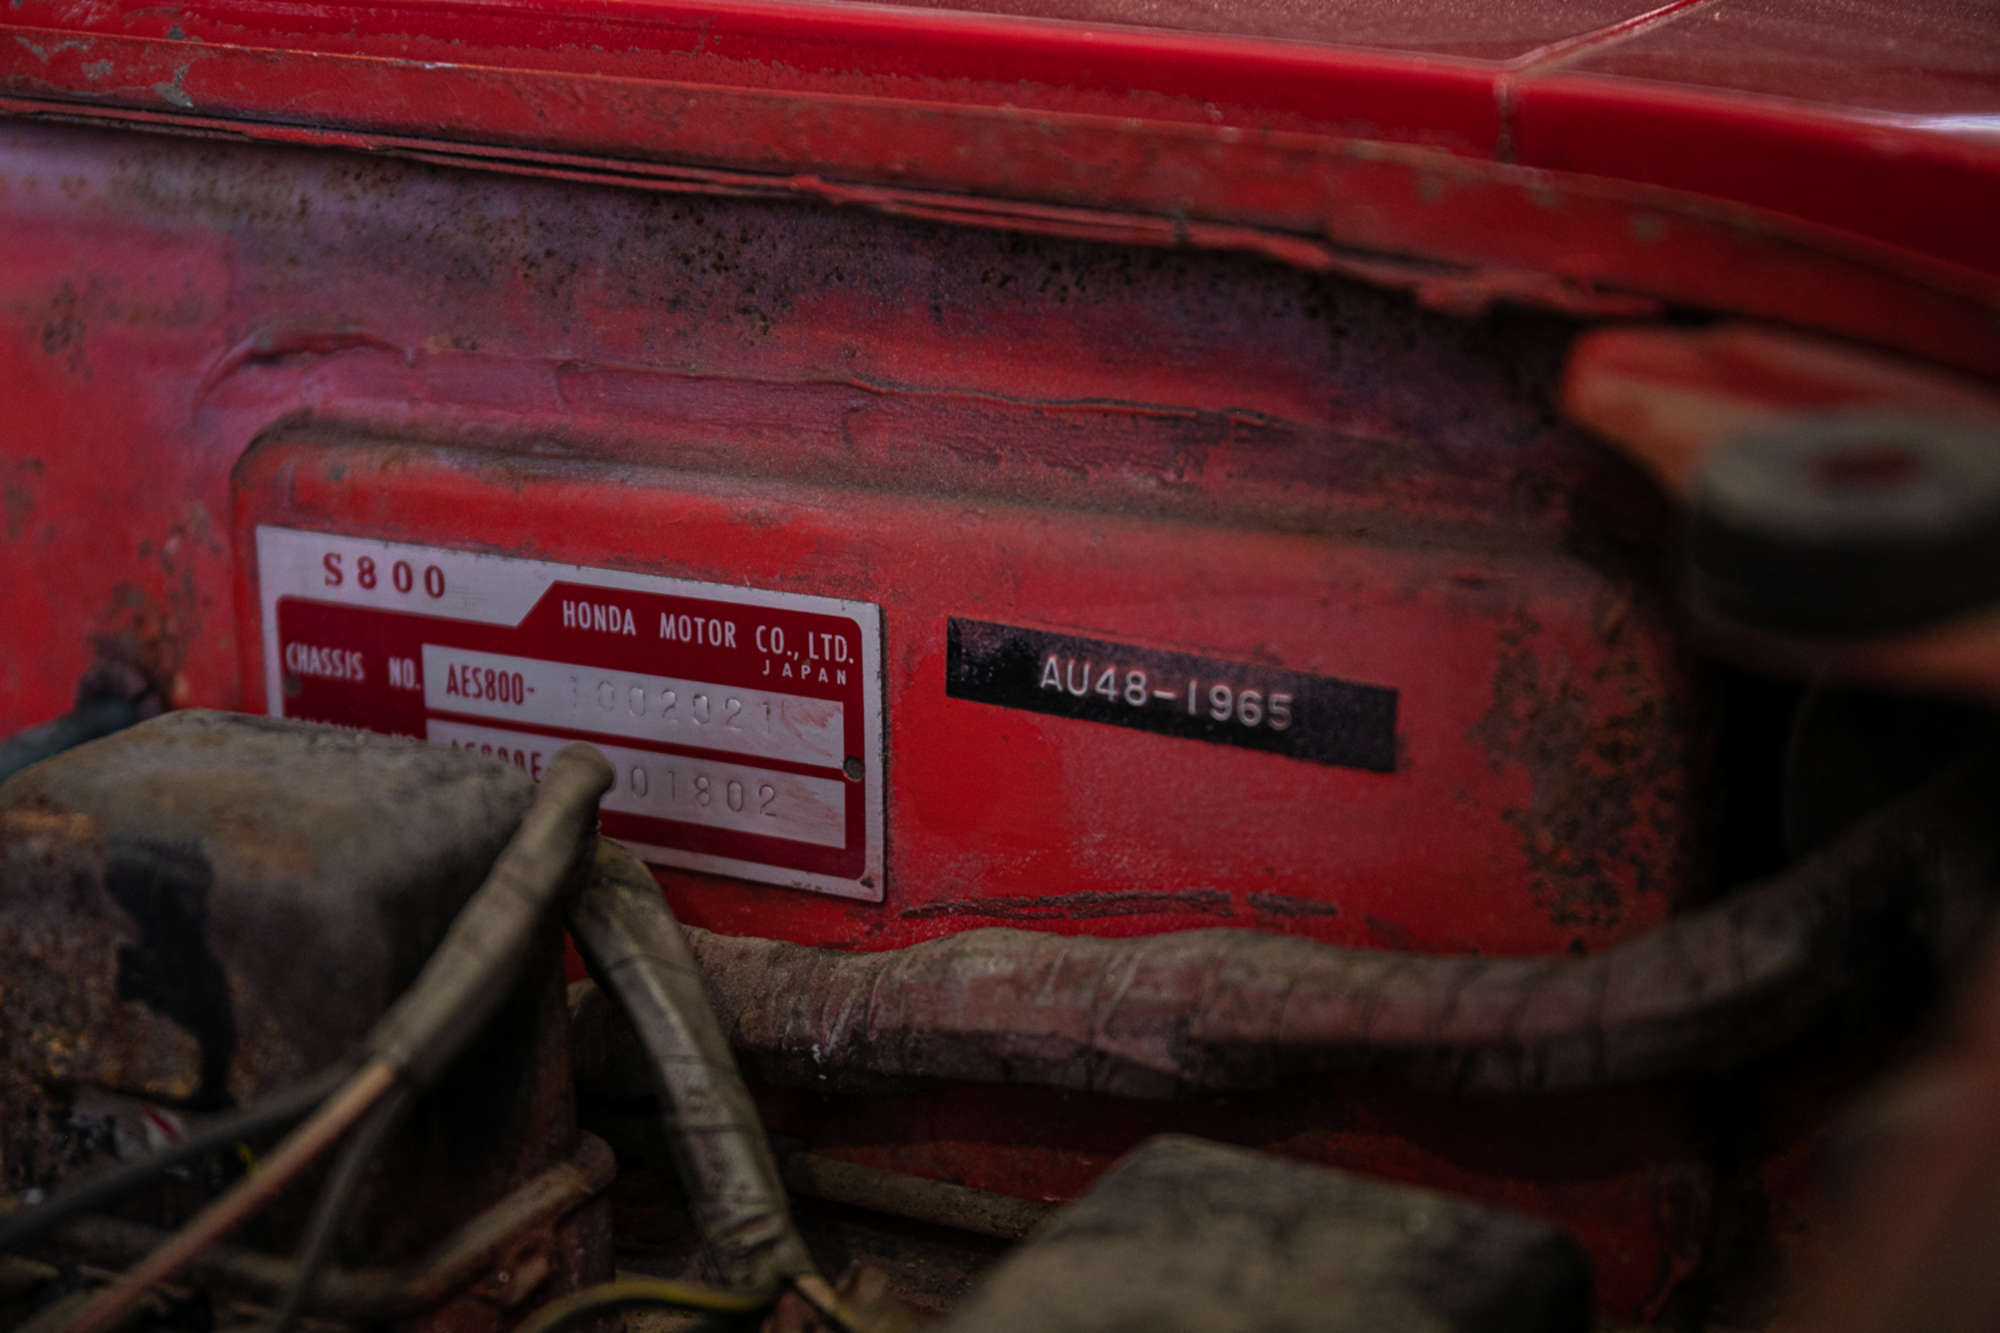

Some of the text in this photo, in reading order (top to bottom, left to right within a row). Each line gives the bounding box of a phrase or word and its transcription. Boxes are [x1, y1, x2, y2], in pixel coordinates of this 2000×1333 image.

[322, 552, 446, 599] S800
[562, 600, 855, 665] HONDA MOTOR CO., LTD.
[285, 642, 421, 690] CHASSIS NO.
[446, 664, 535, 705] AES800-
[762, 660, 847, 686] JAPAN
[1039, 655, 1294, 731] AU48-1965
